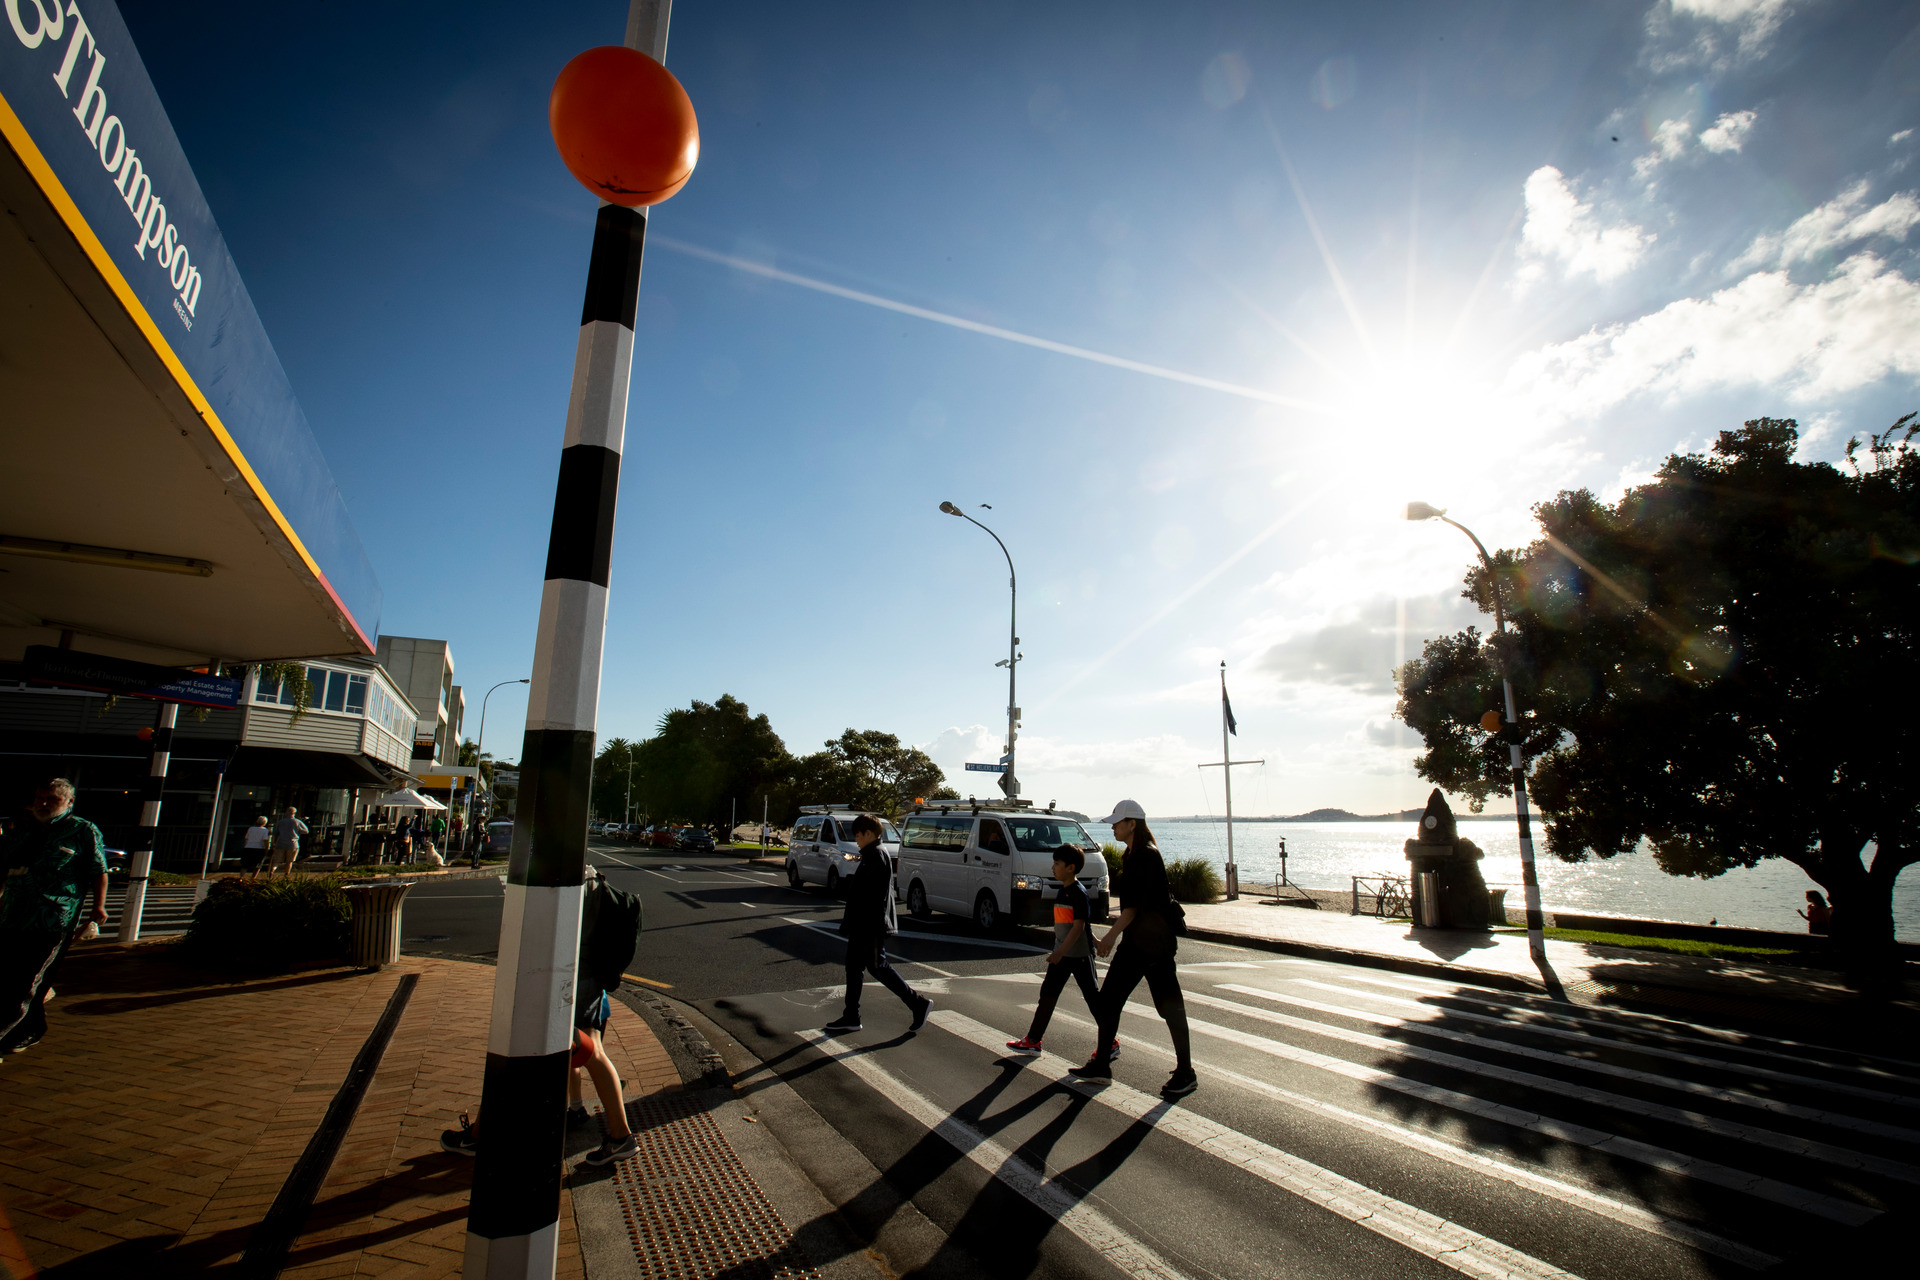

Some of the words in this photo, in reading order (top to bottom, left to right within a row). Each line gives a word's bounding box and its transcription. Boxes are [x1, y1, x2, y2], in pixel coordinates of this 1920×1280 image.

[53, 0, 202, 317] Thompson
[172, 298, 193, 332] MREINZ
[154, 681, 186, 693] roperty
[186, 687, 232, 699] Management
[193, 681, 215, 690] Estate
[215, 684, 233, 693] Sales
